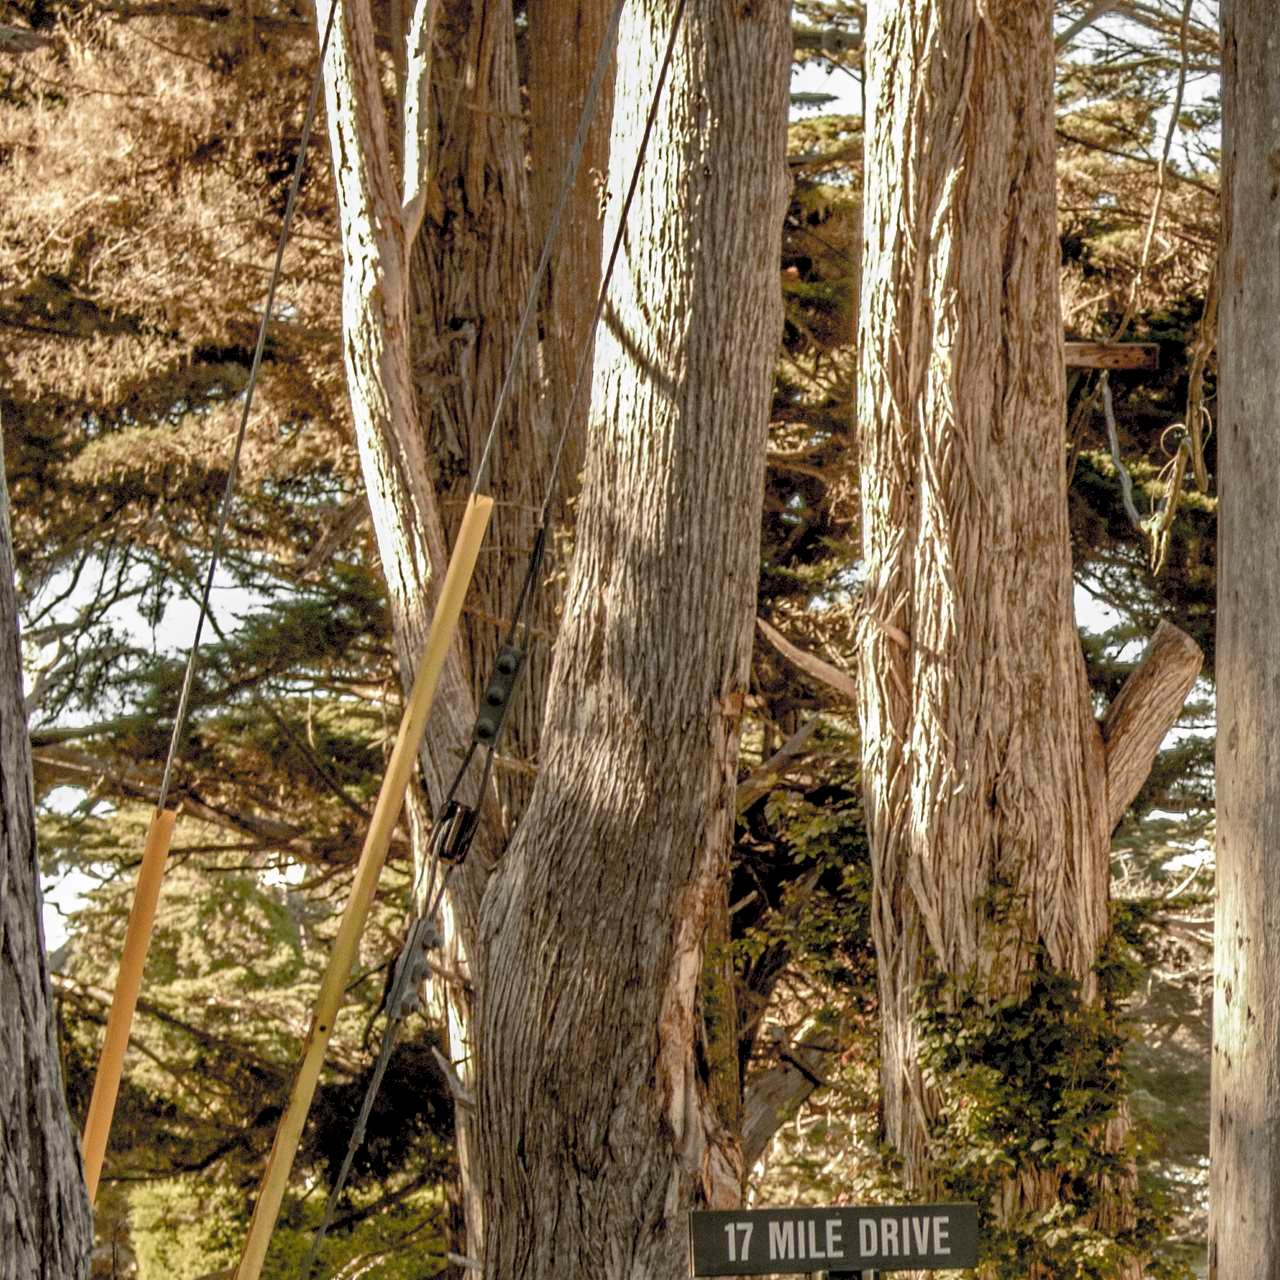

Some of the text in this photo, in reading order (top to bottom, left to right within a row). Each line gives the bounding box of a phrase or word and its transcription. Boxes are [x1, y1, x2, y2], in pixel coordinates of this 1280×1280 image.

[724, 1216, 951, 1262] 17 MILE DRIVE
